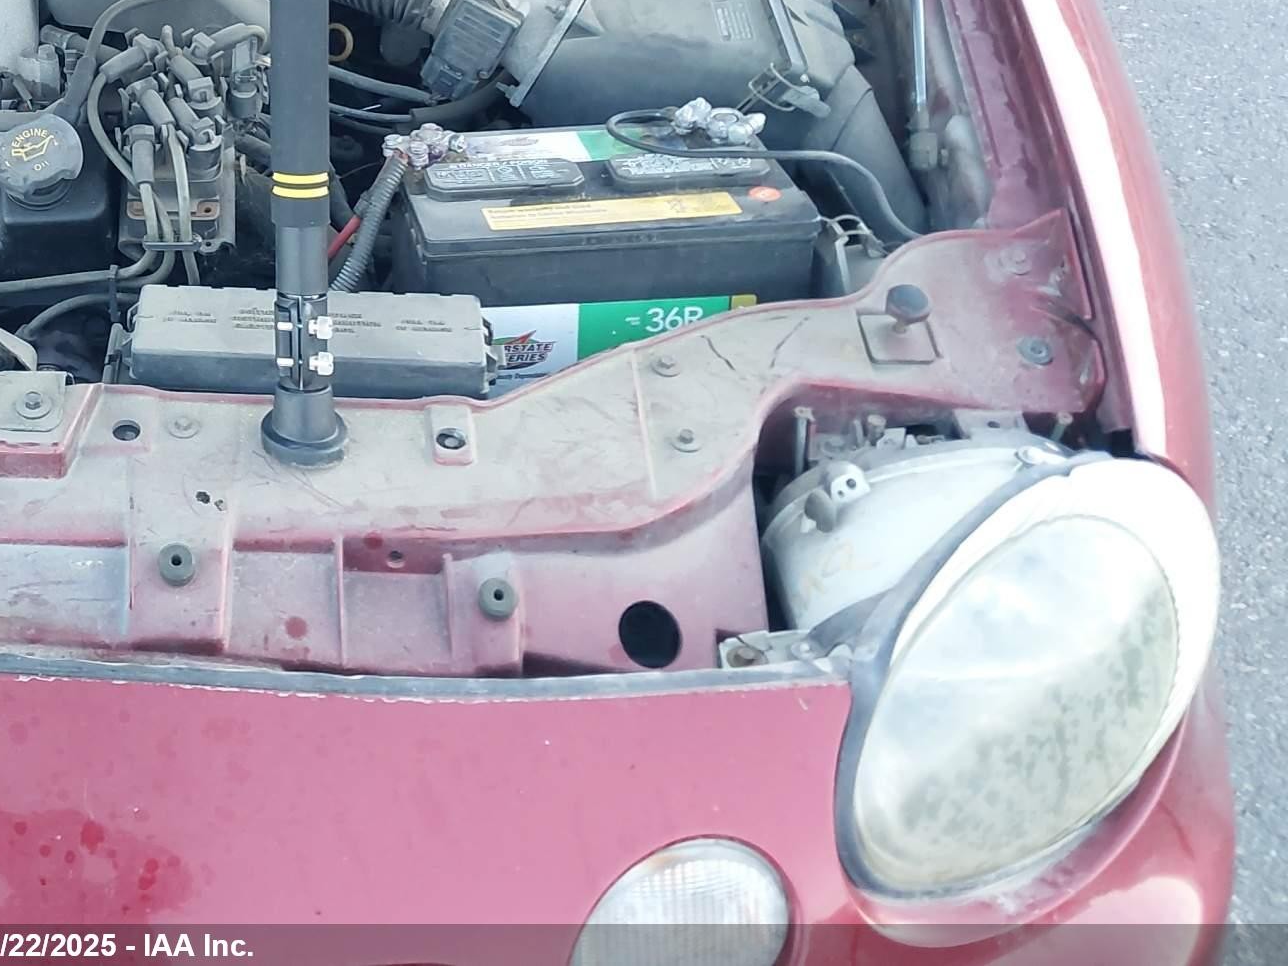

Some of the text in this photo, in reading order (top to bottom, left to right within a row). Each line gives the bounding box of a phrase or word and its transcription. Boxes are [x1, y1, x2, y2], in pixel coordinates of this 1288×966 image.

[12, 128, 49, 147] ENGINE
[504, 342, 553, 353] RSTATE
[508, 353, 546, 363] ERIES
